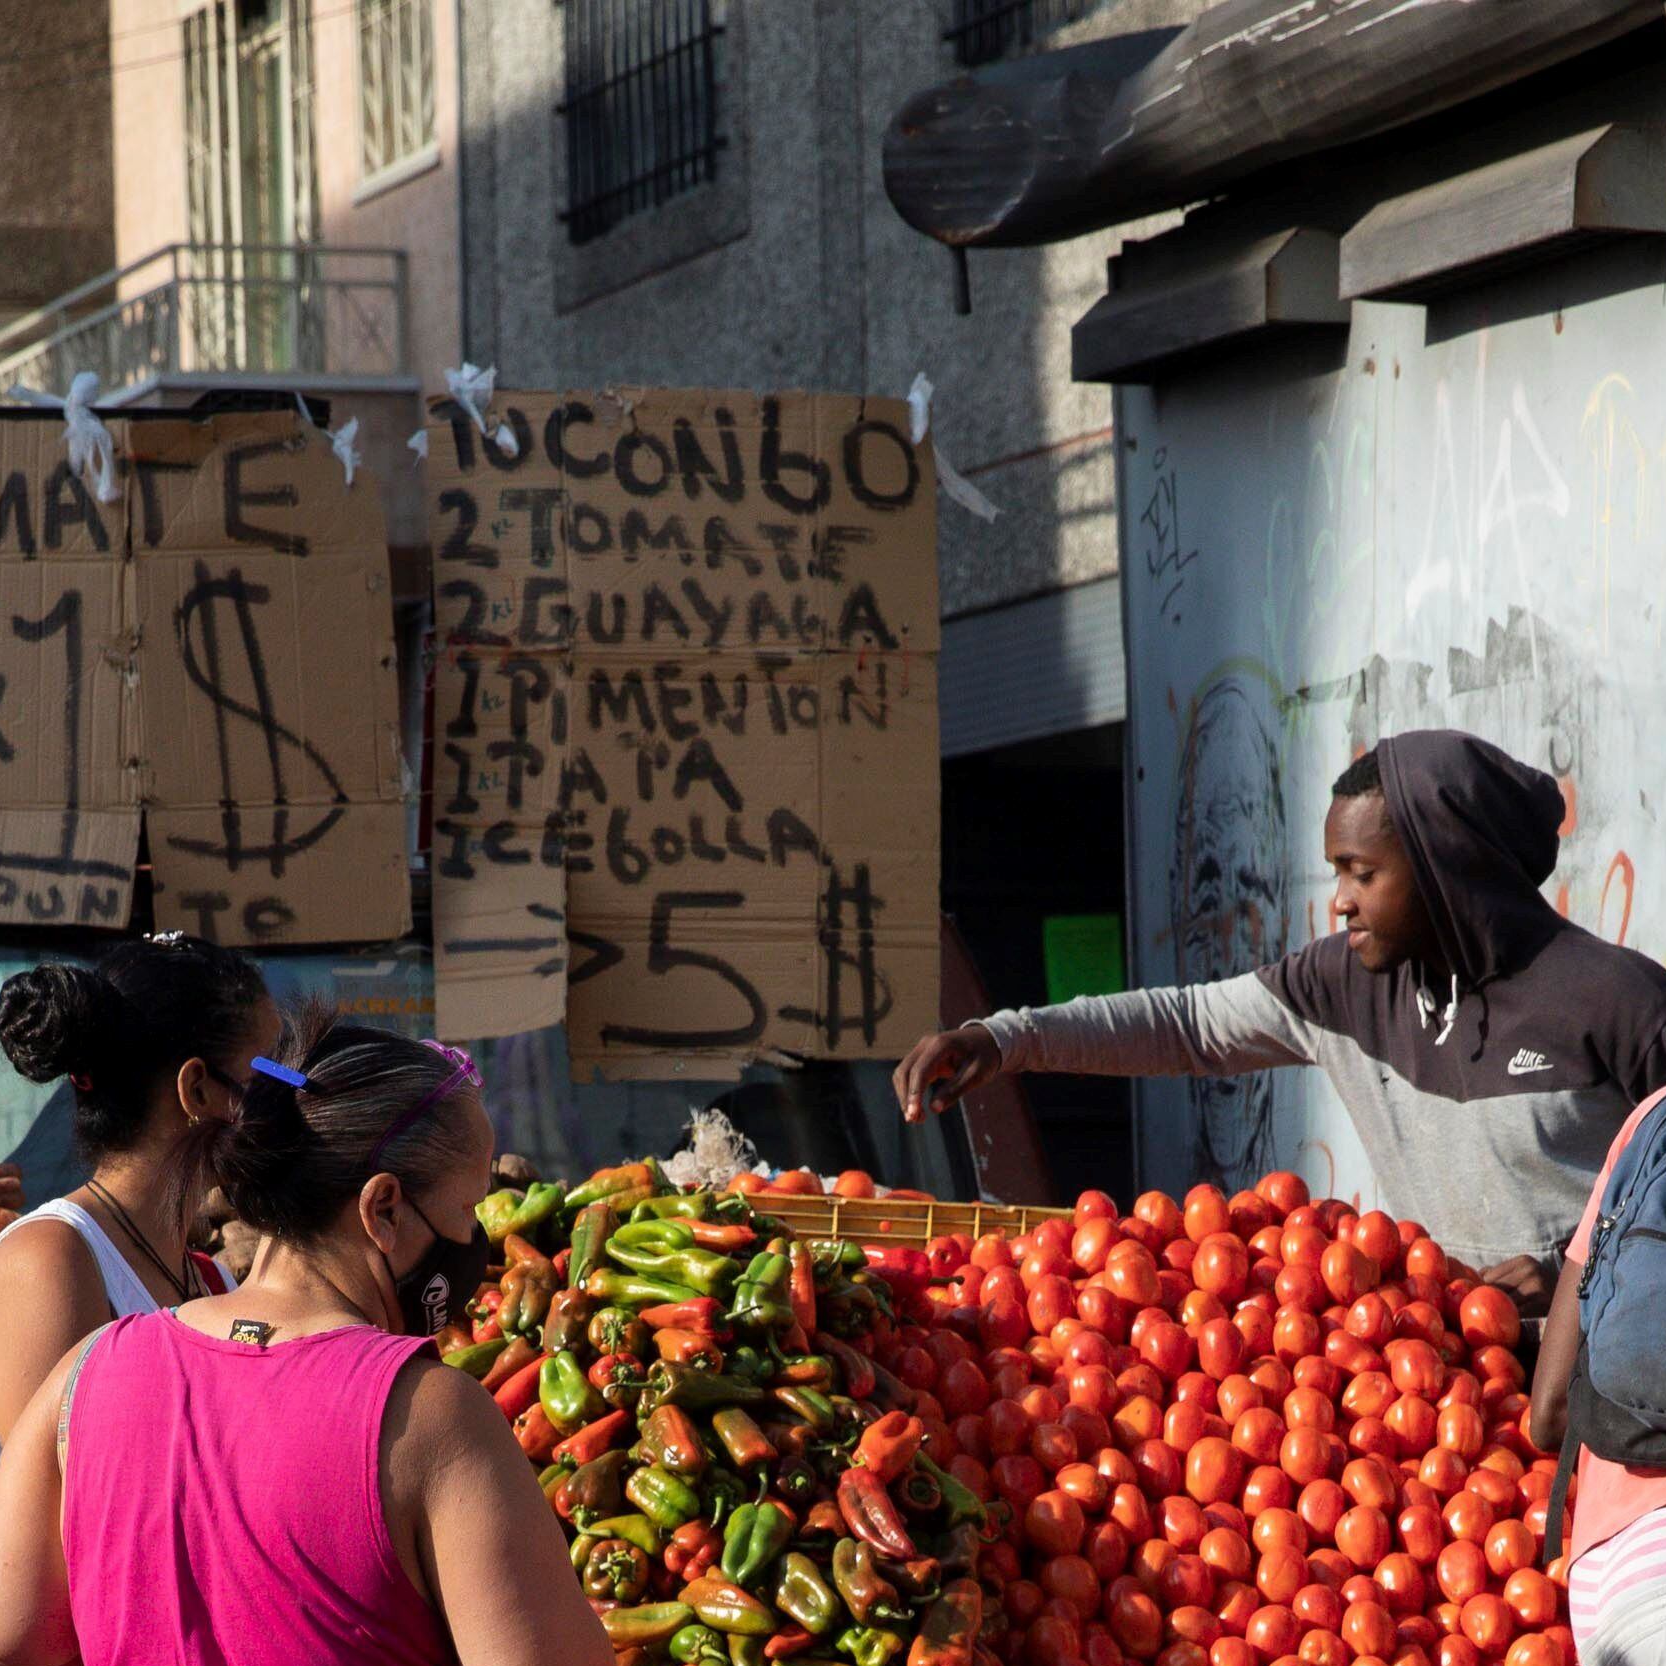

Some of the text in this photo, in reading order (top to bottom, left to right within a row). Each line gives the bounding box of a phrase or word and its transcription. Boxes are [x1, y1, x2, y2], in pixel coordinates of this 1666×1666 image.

[439, 489, 499, 568] 2
[499, 488, 875, 582] TOMATE
[439, 579, 512, 645] 2
[168, 560, 350, 878] $
[599, 862, 892, 1050] 5 $
[1514, 1048, 1546, 1069] NIKE
